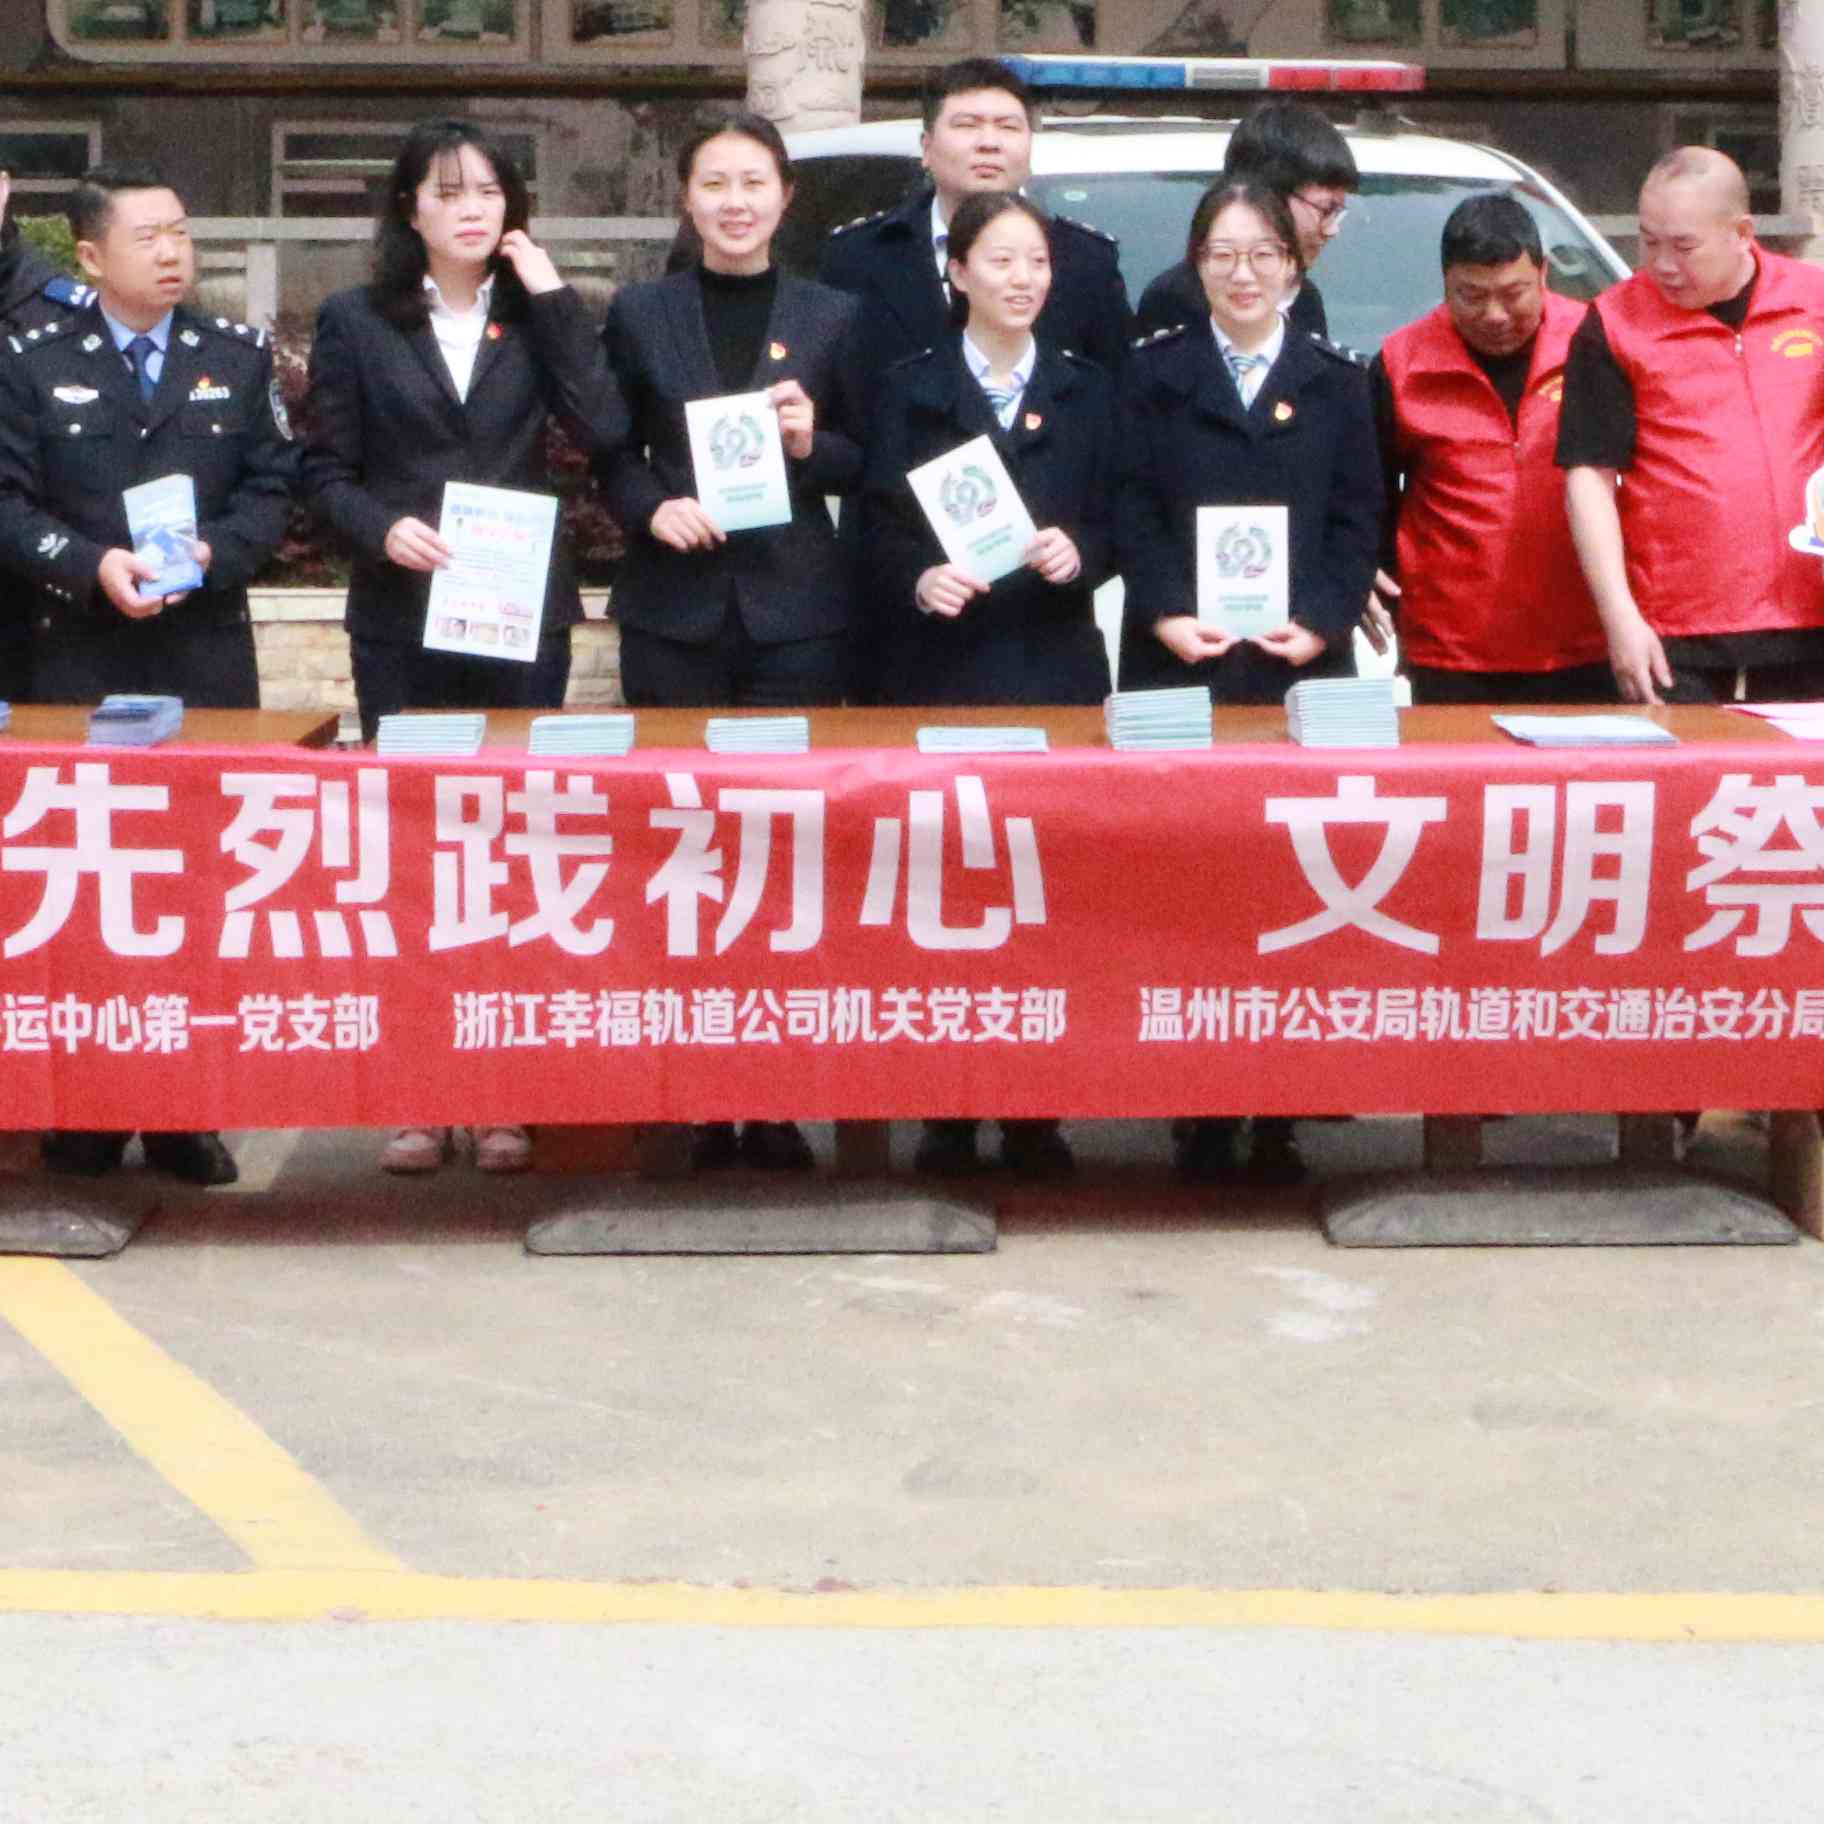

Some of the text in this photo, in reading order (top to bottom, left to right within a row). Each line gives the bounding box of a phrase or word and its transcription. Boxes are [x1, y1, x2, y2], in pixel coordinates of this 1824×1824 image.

[452, 985, 1067, 1050] 浙江幸福轨道公司机关党支部
